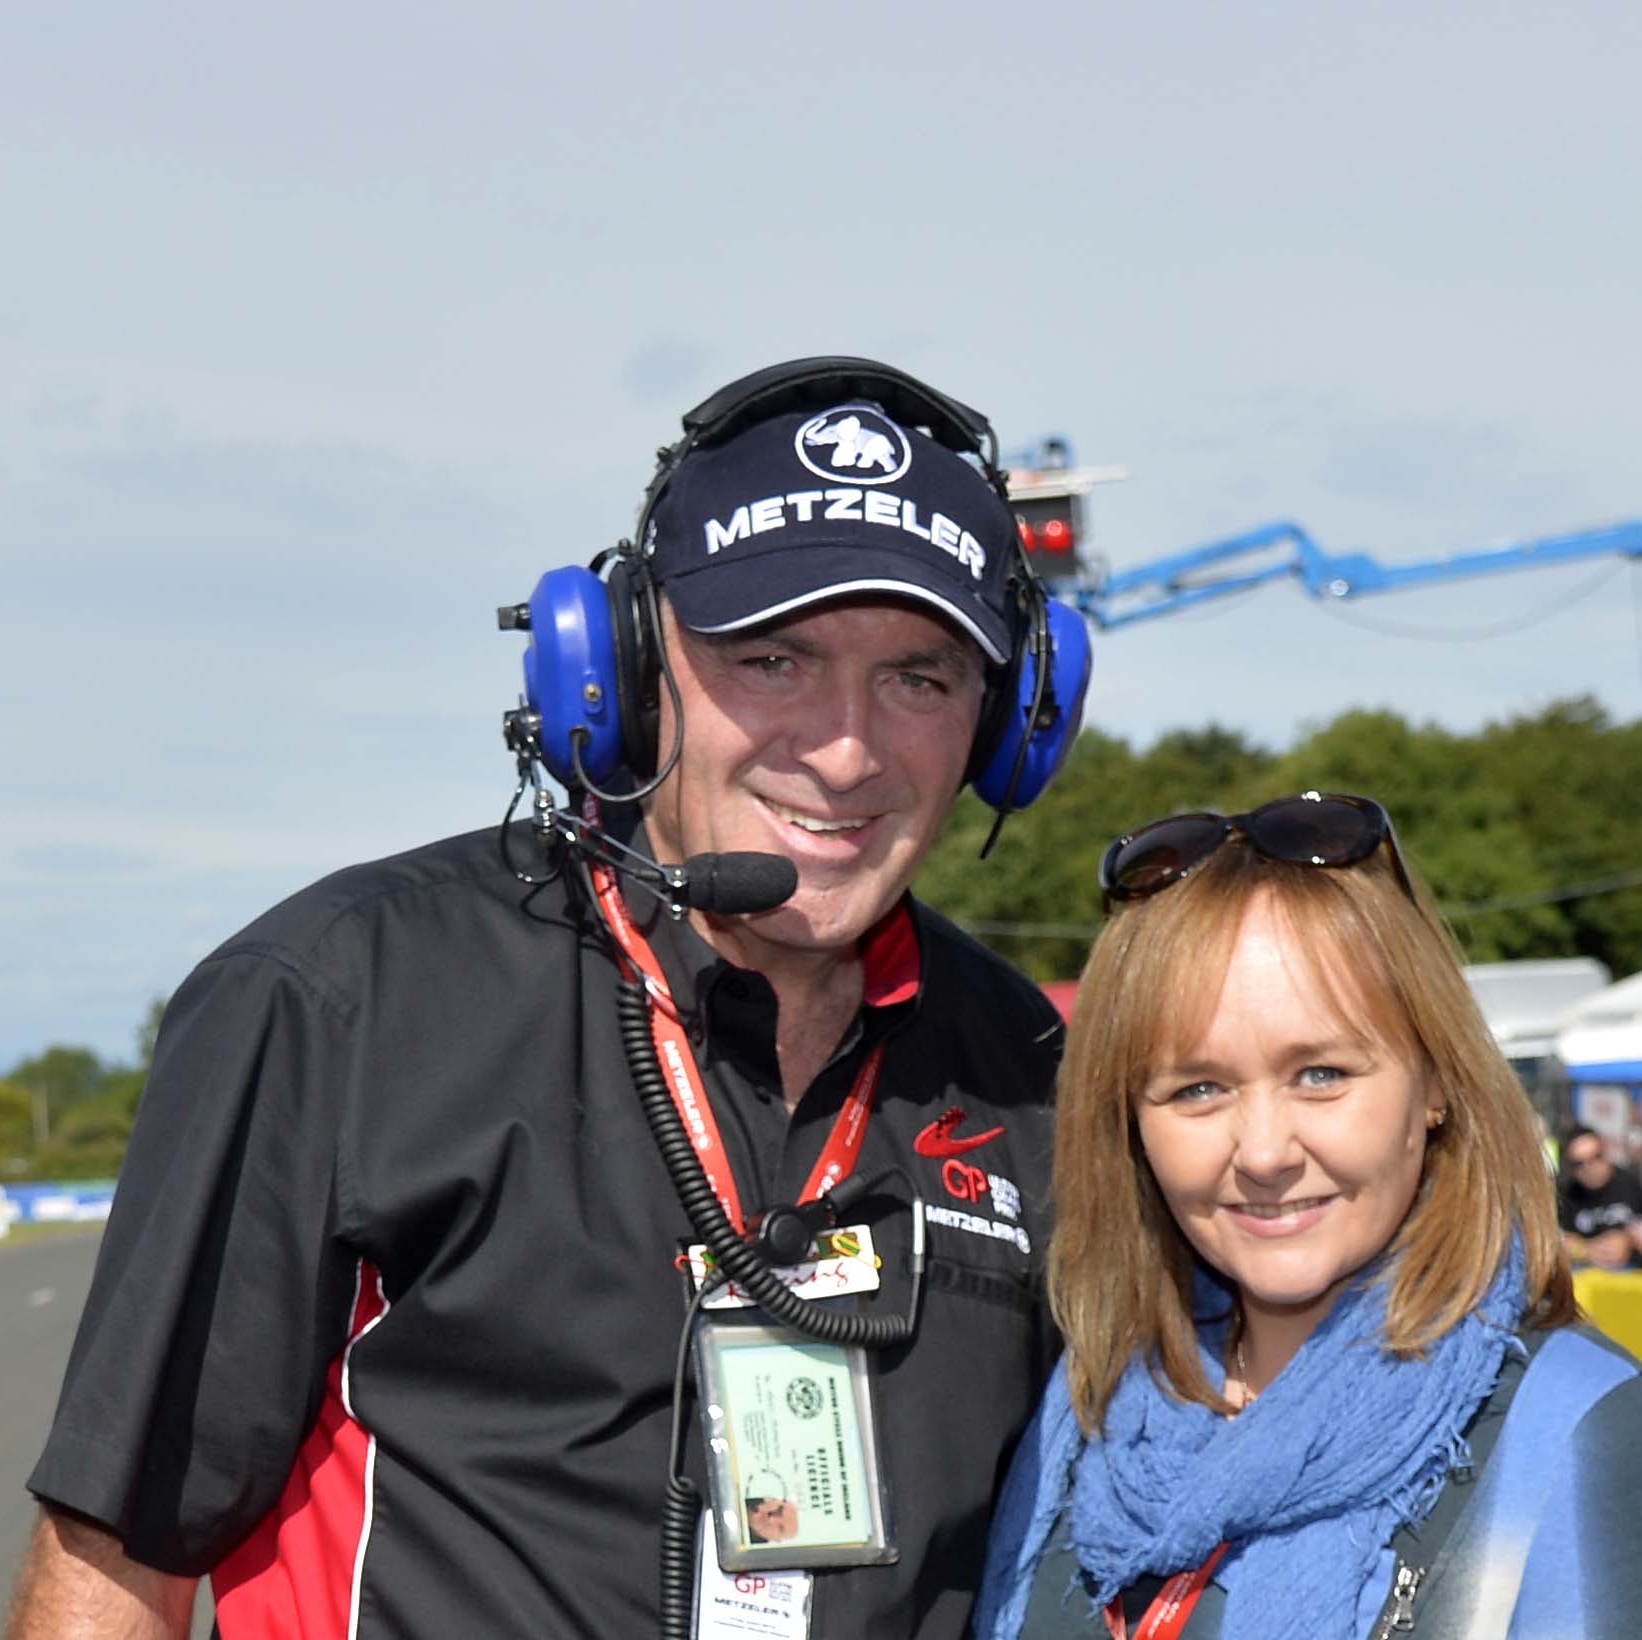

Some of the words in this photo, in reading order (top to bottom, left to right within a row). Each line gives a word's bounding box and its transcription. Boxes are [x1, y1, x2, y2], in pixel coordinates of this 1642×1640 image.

[704, 488, 988, 583] METZELER
[662, 1039, 706, 1138] METZELER
[941, 1158, 988, 1204] GP
[714, 1596, 779, 1616] METZELER
[734, 1570, 767, 1596] GP
